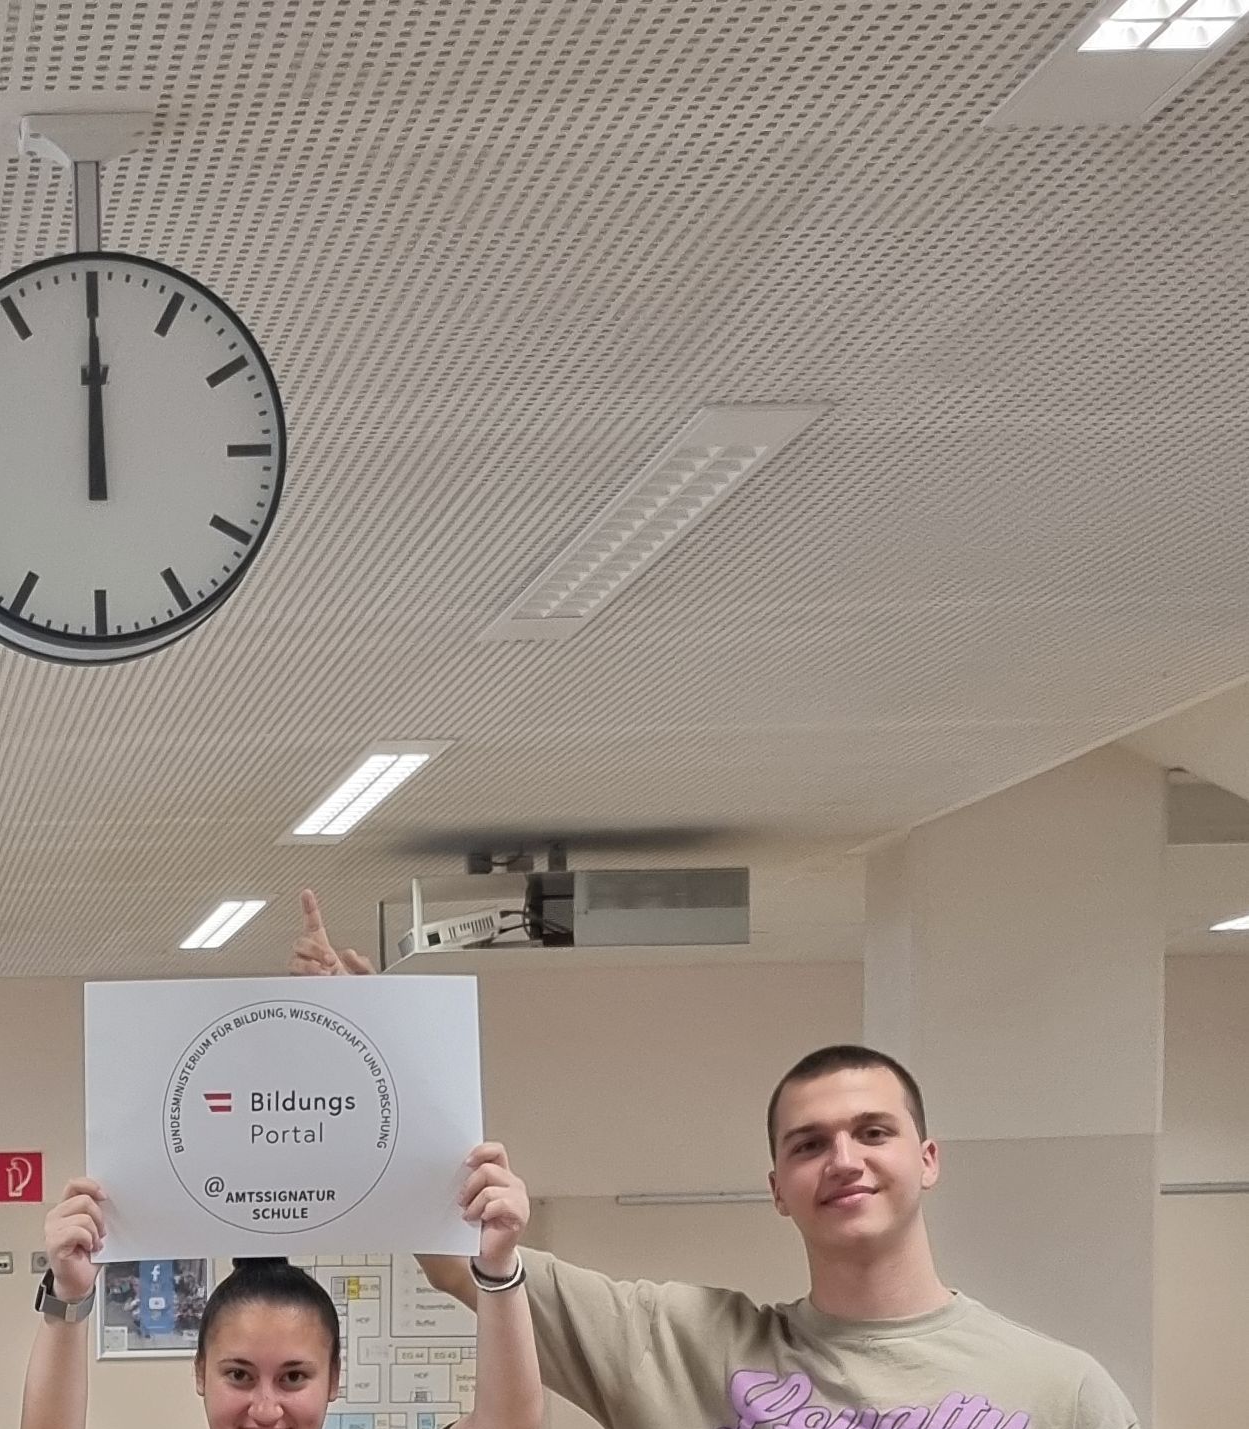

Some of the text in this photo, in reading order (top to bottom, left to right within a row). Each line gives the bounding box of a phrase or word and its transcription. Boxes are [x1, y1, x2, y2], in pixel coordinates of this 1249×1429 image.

[170, 1007, 391, 1154] BUNDESMINISTERIUM FÜR BILDUNG, WISSENSCHAFT UND FORSCHUNG
[251, 1091, 356, 1116] Bildungs
[251, 1122, 325, 1144] Portal
[225, 1189, 336, 1204] AMTSSIGNATUR
[252, 1207, 309, 1220] SCHULE
